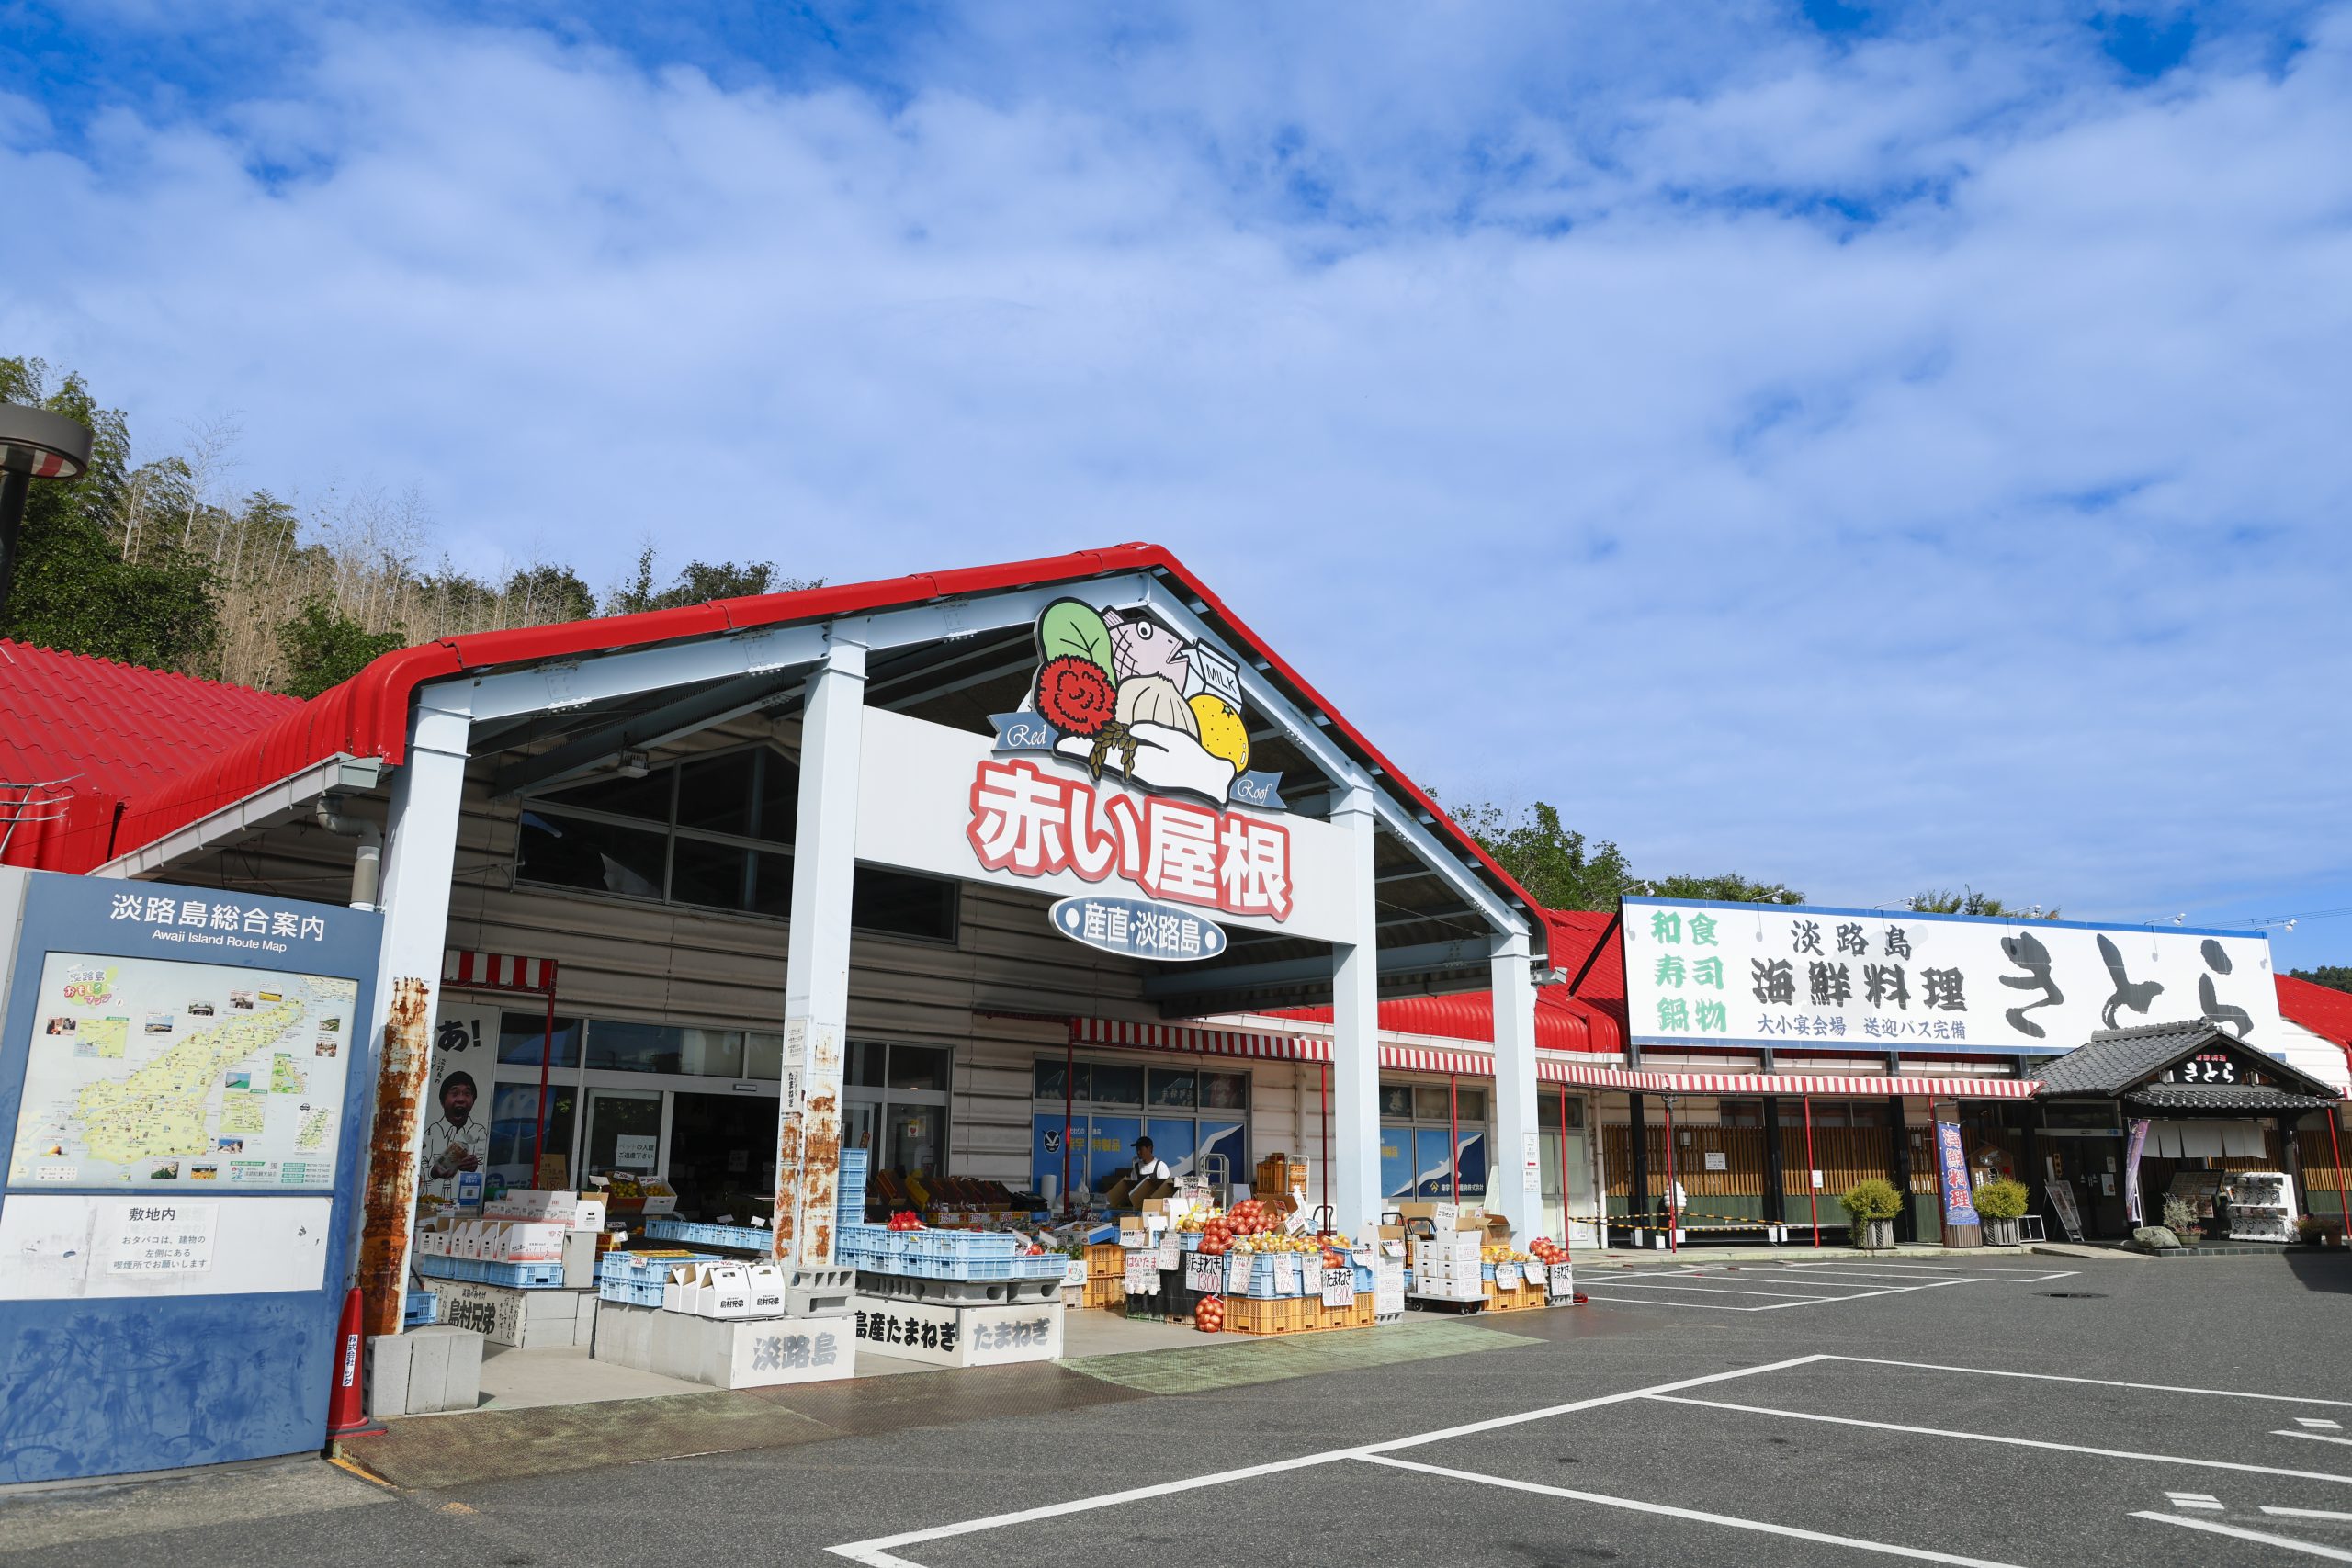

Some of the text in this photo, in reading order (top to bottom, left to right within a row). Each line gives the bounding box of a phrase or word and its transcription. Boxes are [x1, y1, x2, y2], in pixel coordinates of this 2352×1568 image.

[1205, 663, 1238, 694] MILK
[1006, 724, 1046, 748] Red
[1237, 779, 1272, 804] Roof
[976, 766, 1288, 915] 赤い屋根
[109, 893, 326, 942] 淡路島総合案内
[1650, 909, 1720, 947] 和食
[152, 929, 287, 953] Awaji Island Route Map
[1791, 919, 1913, 961] 淡路島
[1655, 953, 1724, 990] 寿司
[1751, 957, 1968, 1011] 海鮮料理
[1657, 997, 1727, 1032] 鍋物
[1757, 1013, 1967, 1041] 大小宴会場 送迎バス完備
[1942, 1128, 1971, 1210] 海鮮料理
[129, 1207, 175, 1222] 敷地内
[113, 1259, 208, 1269] 喫煙所でお願いします
[145, 1249, 191, 1258] 左側にある
[1126, 1256, 1157, 1269] はなたま
[1190, 1254, 1222, 1275] たまねぎ
[448, 1298, 496, 1335] 島村兄弟
[720, 1300, 744, 1308] 島村兄弟
[855, 1310, 956, 1352] 島産たまねぎ
[974, 1317, 1050, 1350] たまねぎ
[345, 1335, 357, 1367] 株式会社
[752, 1332, 837, 1371] 淡路島
